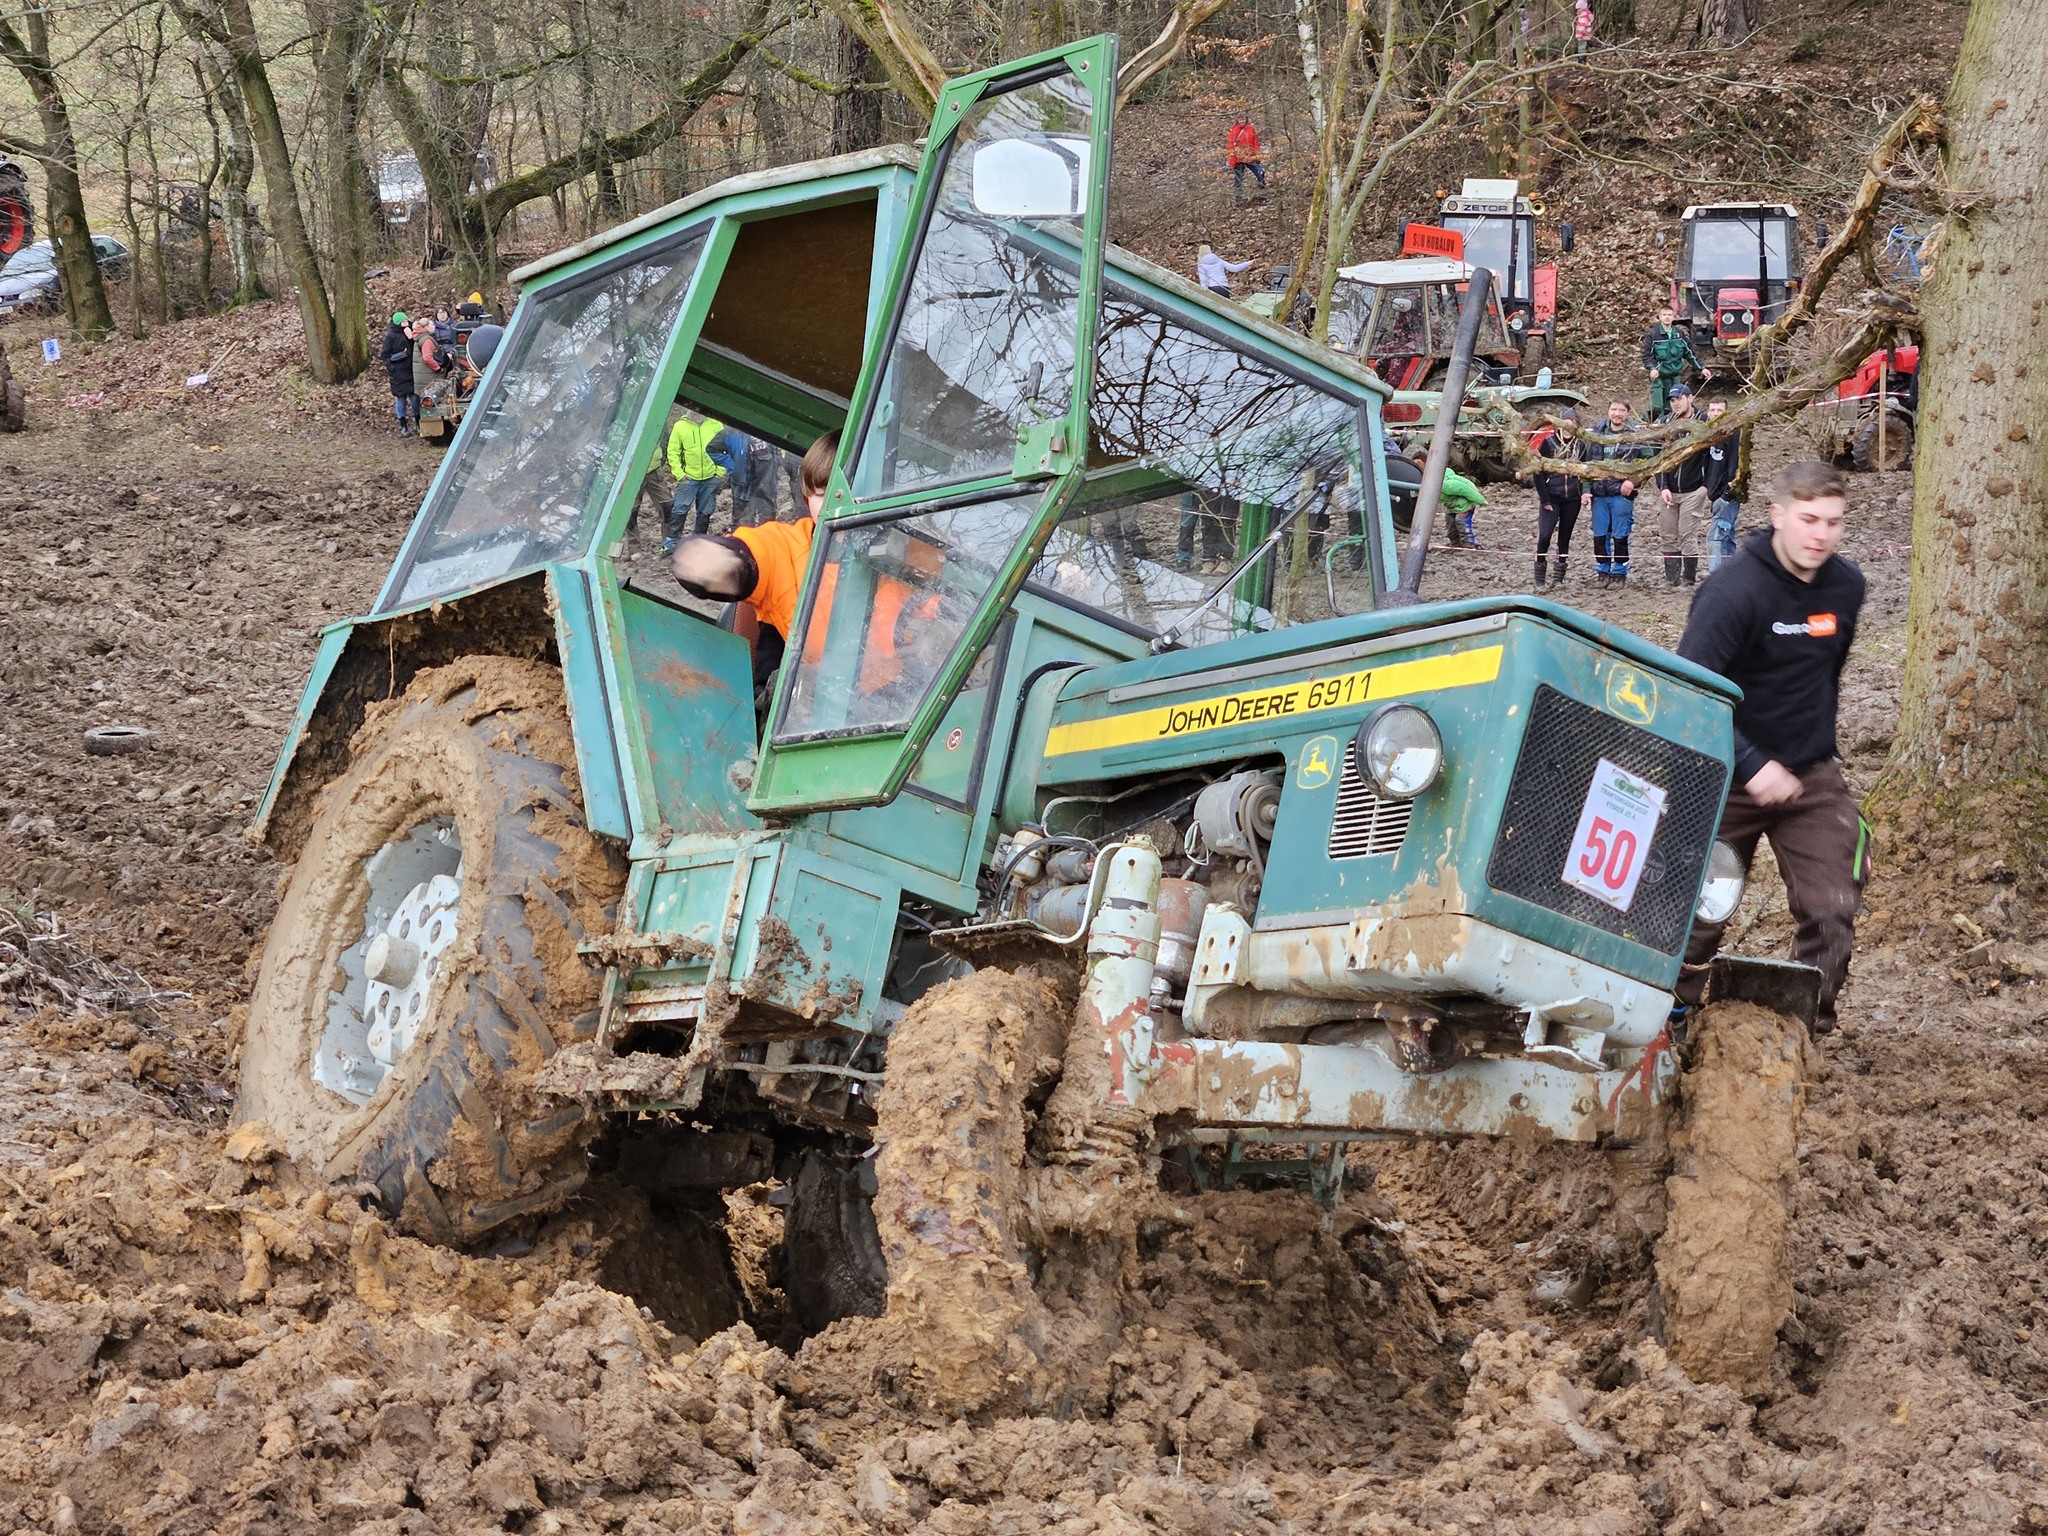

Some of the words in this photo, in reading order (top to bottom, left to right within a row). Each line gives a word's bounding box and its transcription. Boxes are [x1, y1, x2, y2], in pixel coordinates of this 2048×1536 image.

[1463, 204, 1508, 212] ZETOR
[1159, 705, 1219, 736] JOHN
[1221, 691, 1300, 724] DEERE
[1307, 672, 1373, 709] 6911
[1579, 815, 1638, 891] 50
